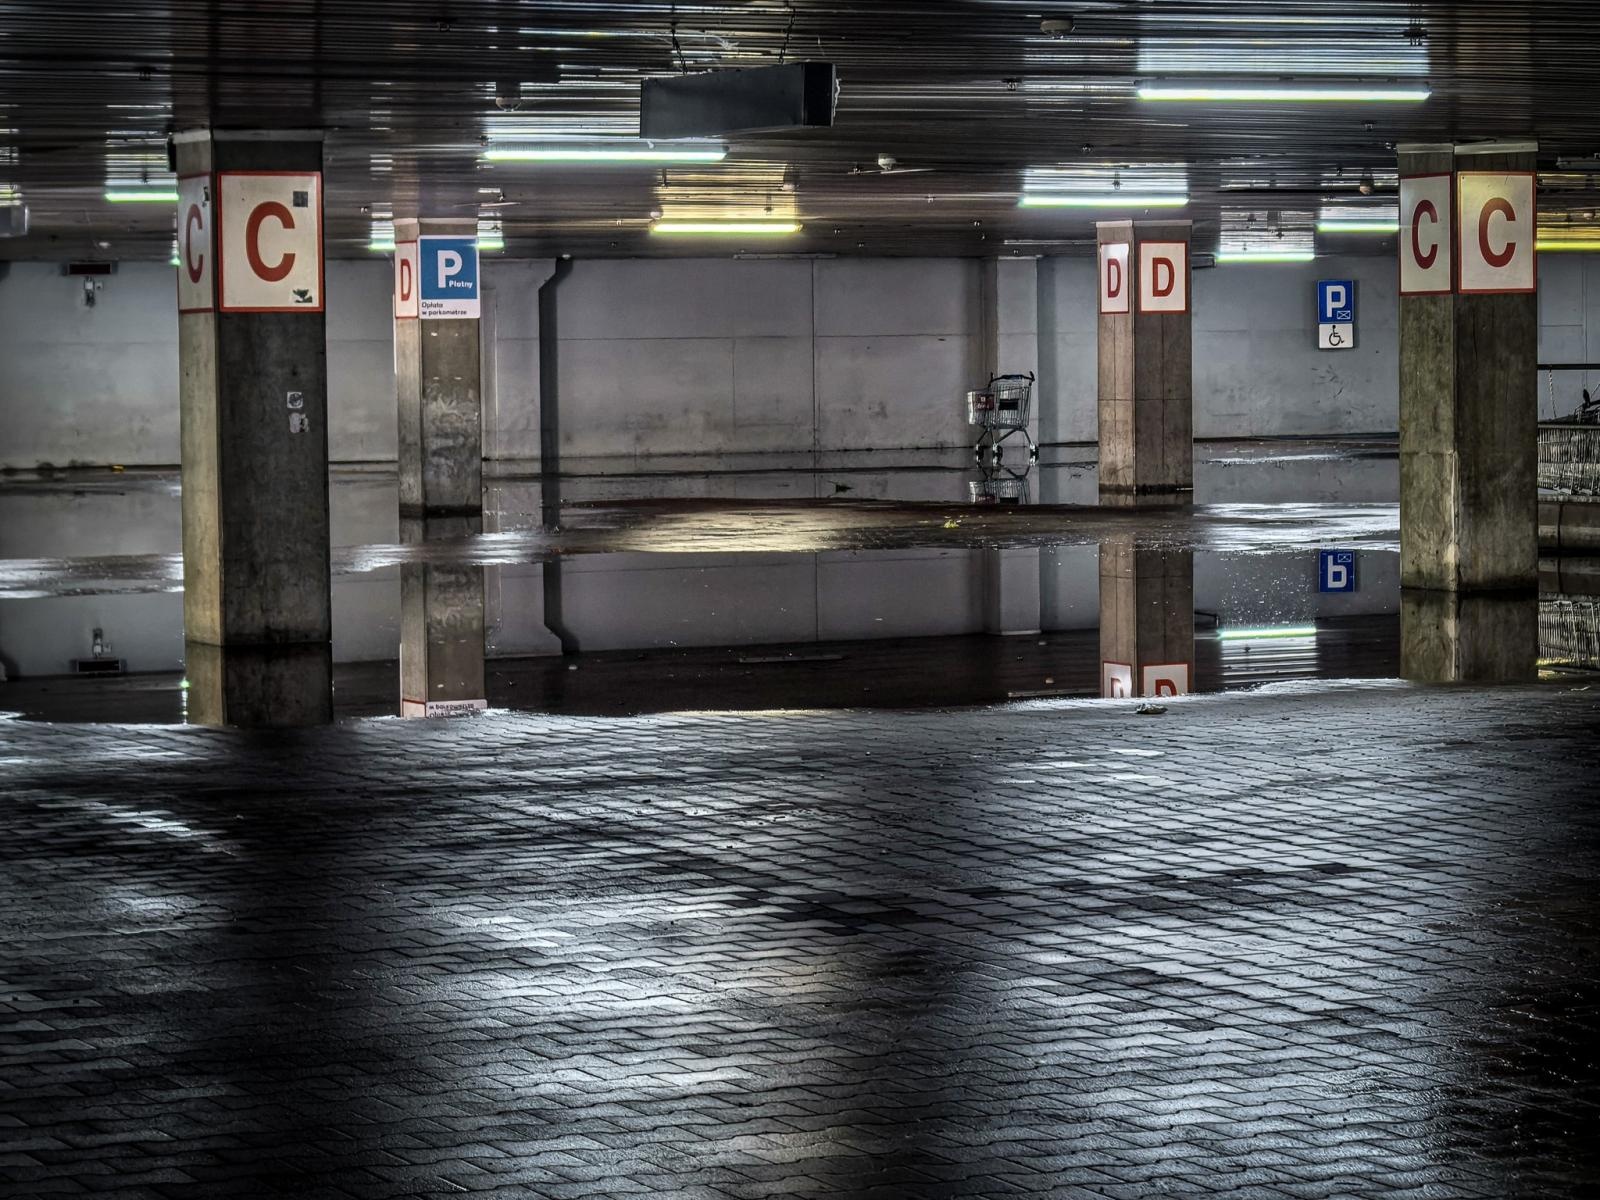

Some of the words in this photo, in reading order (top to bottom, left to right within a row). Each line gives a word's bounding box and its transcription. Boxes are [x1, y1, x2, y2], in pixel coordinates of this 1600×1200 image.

[186, 203, 203, 283] C
[246, 201, 296, 282] C
[1412, 199, 1438, 269] C
[1478, 197, 1516, 268] C
[400, 258, 412, 301] D
[437, 250, 463, 288] P
[1107, 258, 1121, 298] D
[1152, 257, 1175, 297] D
[1326, 285, 1346, 318] P
